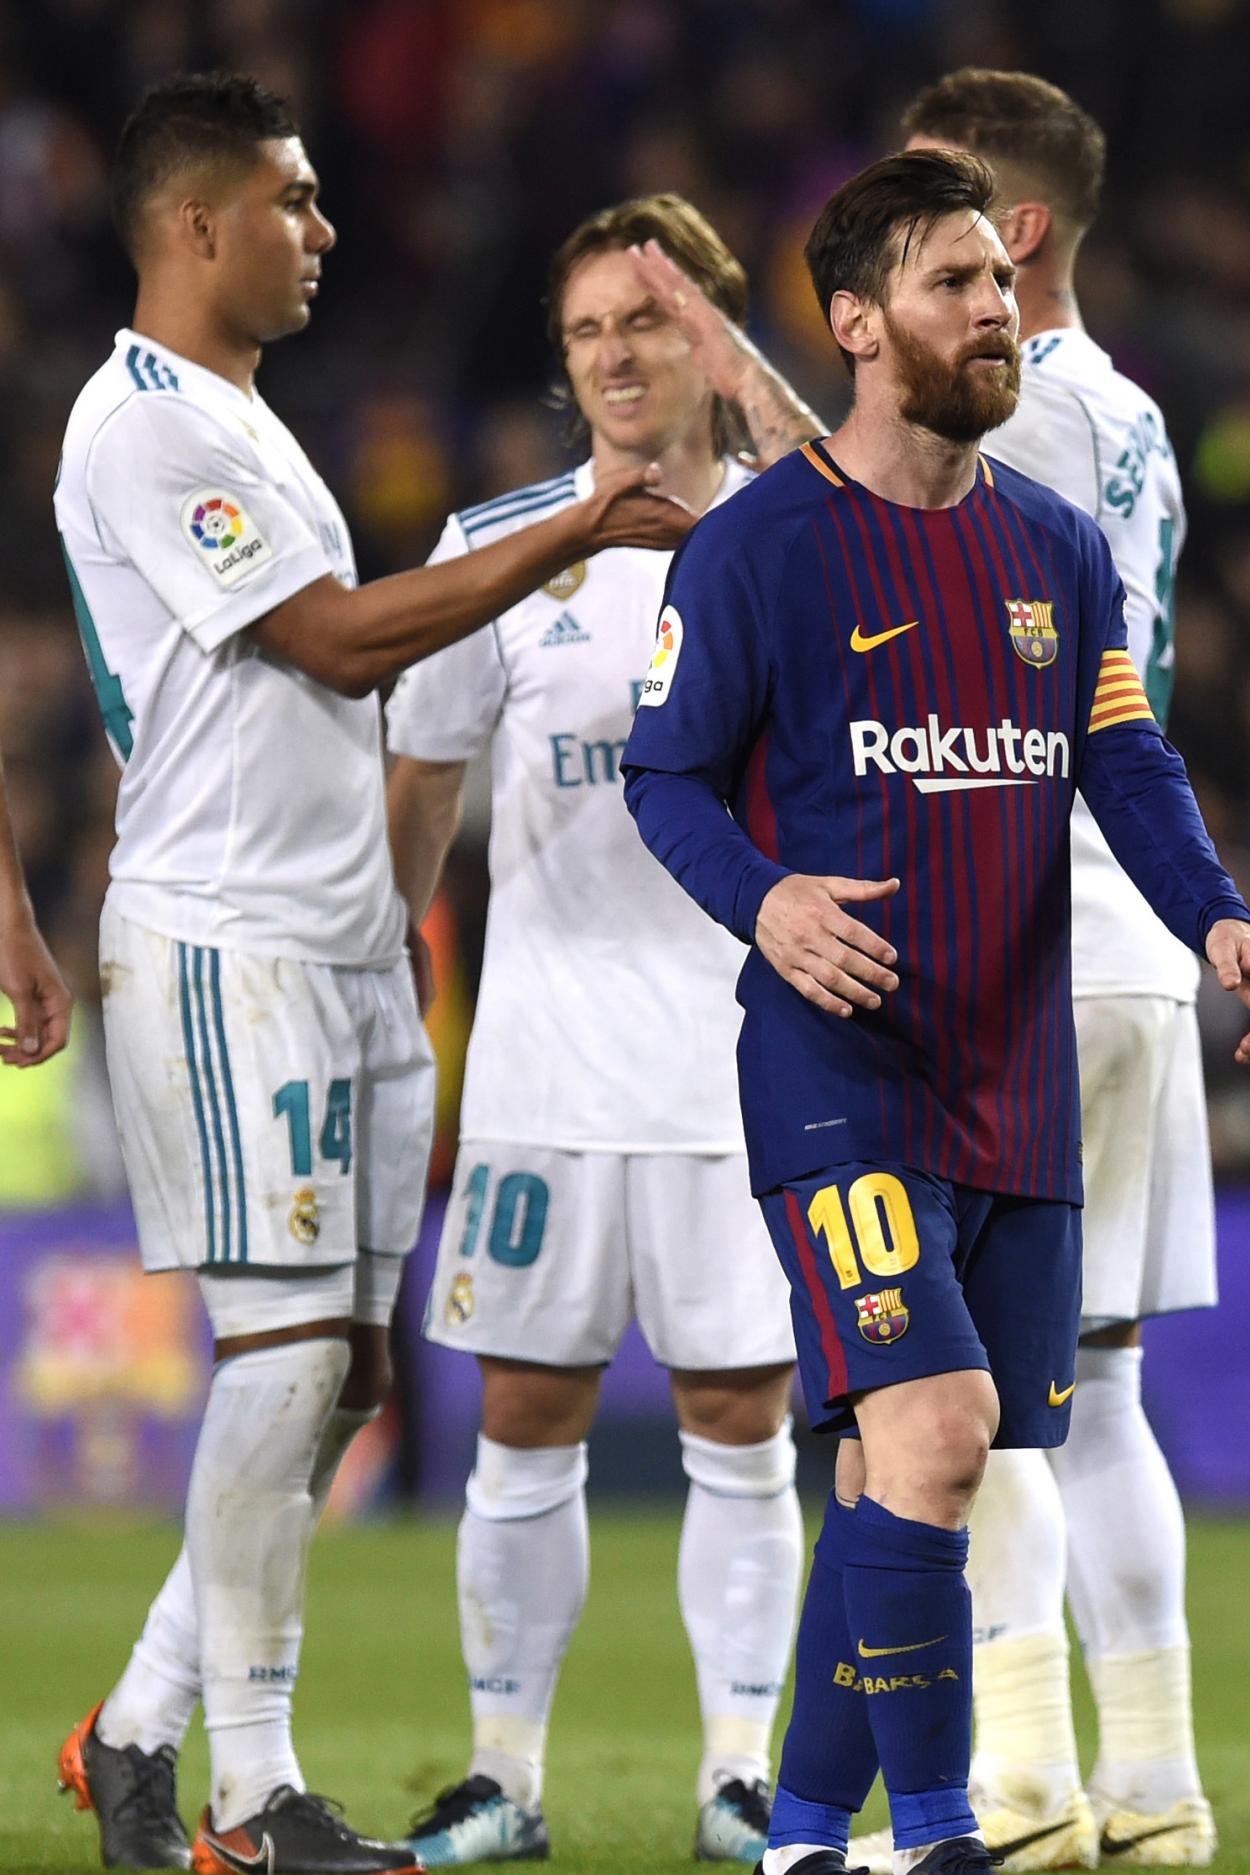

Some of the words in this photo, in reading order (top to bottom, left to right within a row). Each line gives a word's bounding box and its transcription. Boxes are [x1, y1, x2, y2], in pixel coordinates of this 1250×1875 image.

[214, 537, 262, 574] LaLiga
[849, 713, 1070, 778] Rakuten
[272, 1078, 352, 1176] 14
[459, 1163, 549, 1268] 10
[807, 1172, 920, 1290] 10
